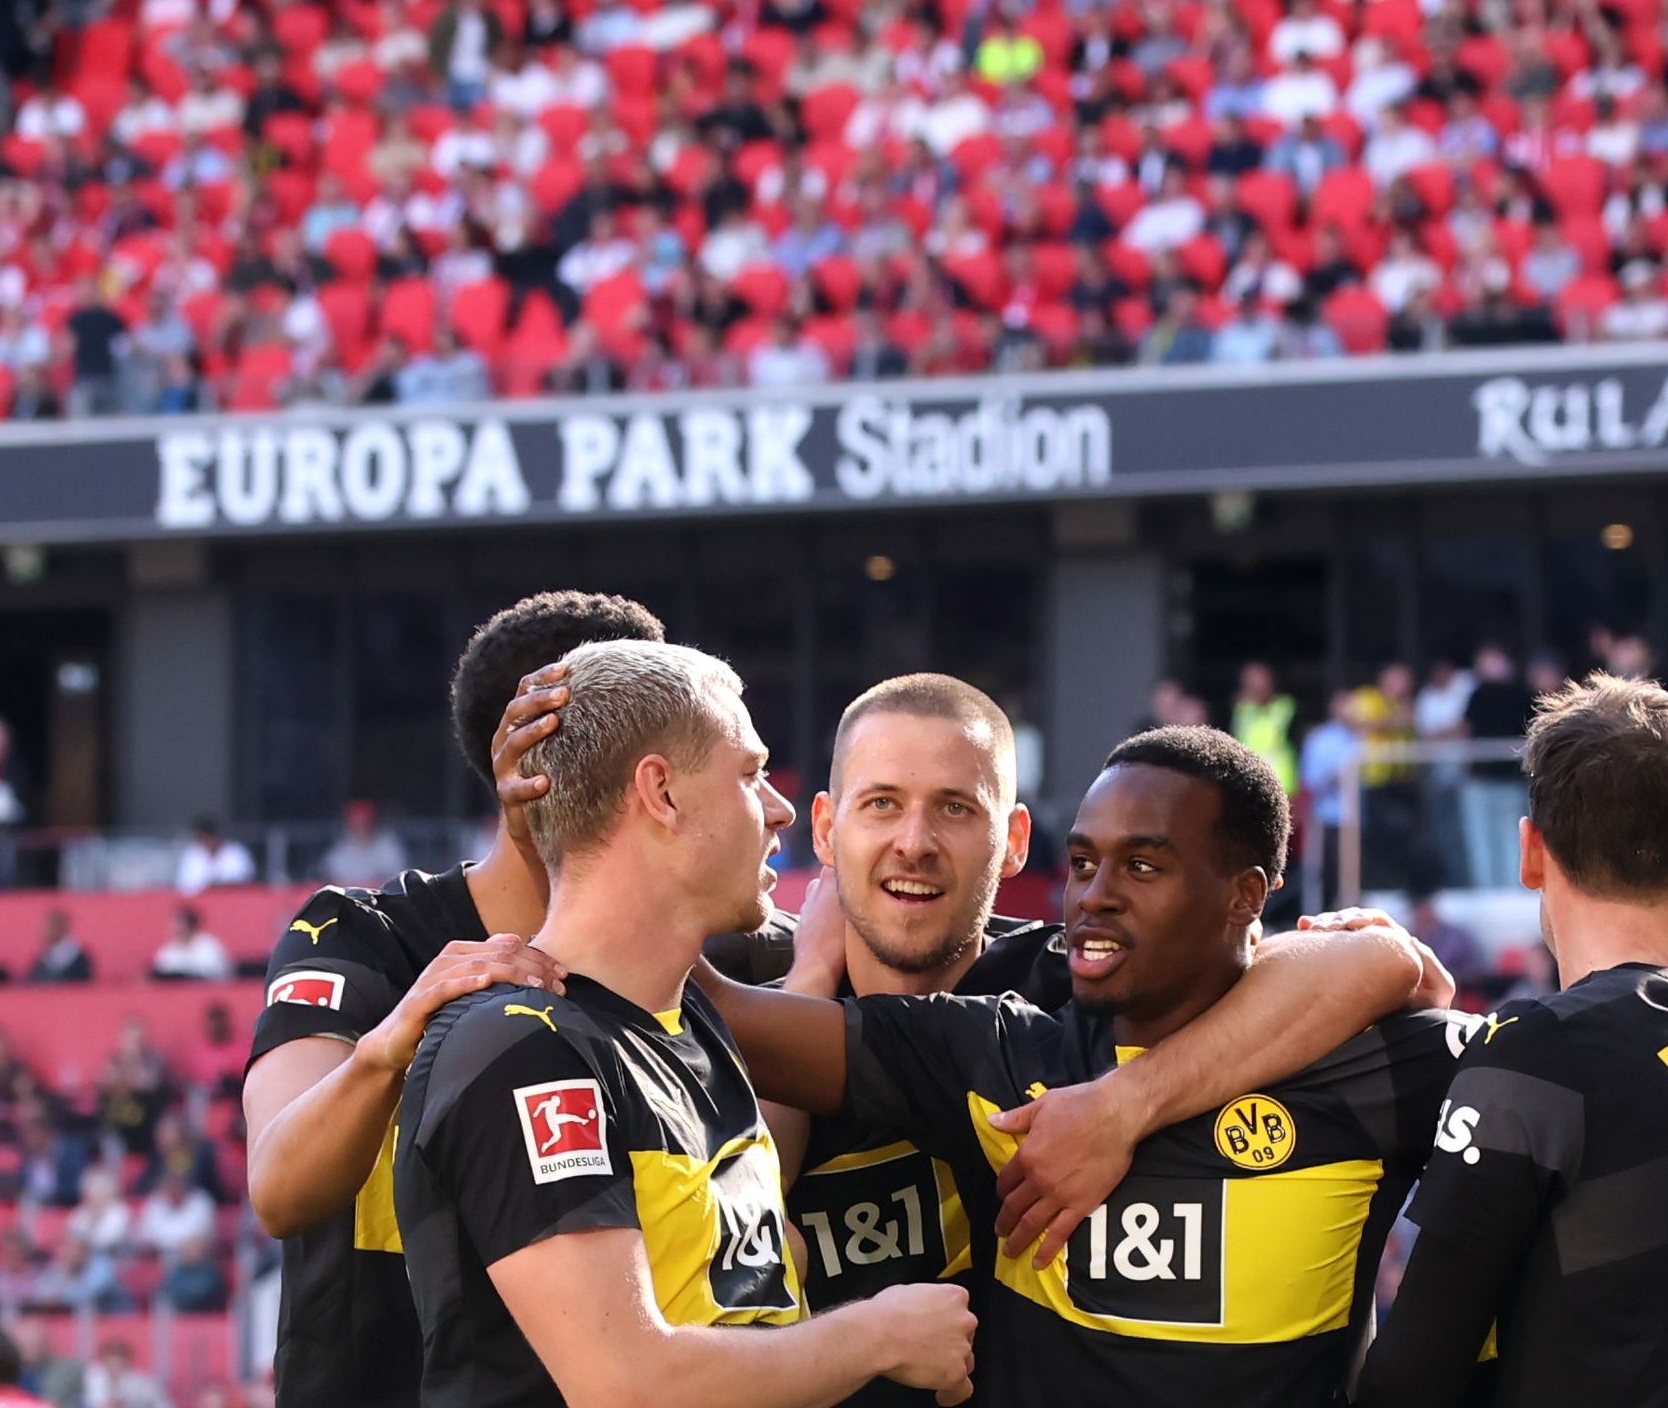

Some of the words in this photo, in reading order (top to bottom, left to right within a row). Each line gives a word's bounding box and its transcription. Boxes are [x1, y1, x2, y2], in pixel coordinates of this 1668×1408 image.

[155, 414, 532, 530] EUROPA
[556, 404, 815, 513] PARK
[836, 397, 1112, 499] Stadion
[539, 1156, 606, 1175] BUNDESLIGA
[801, 1184, 925, 1278] 1&1
[1084, 1202, 1203, 1281] 1&1
